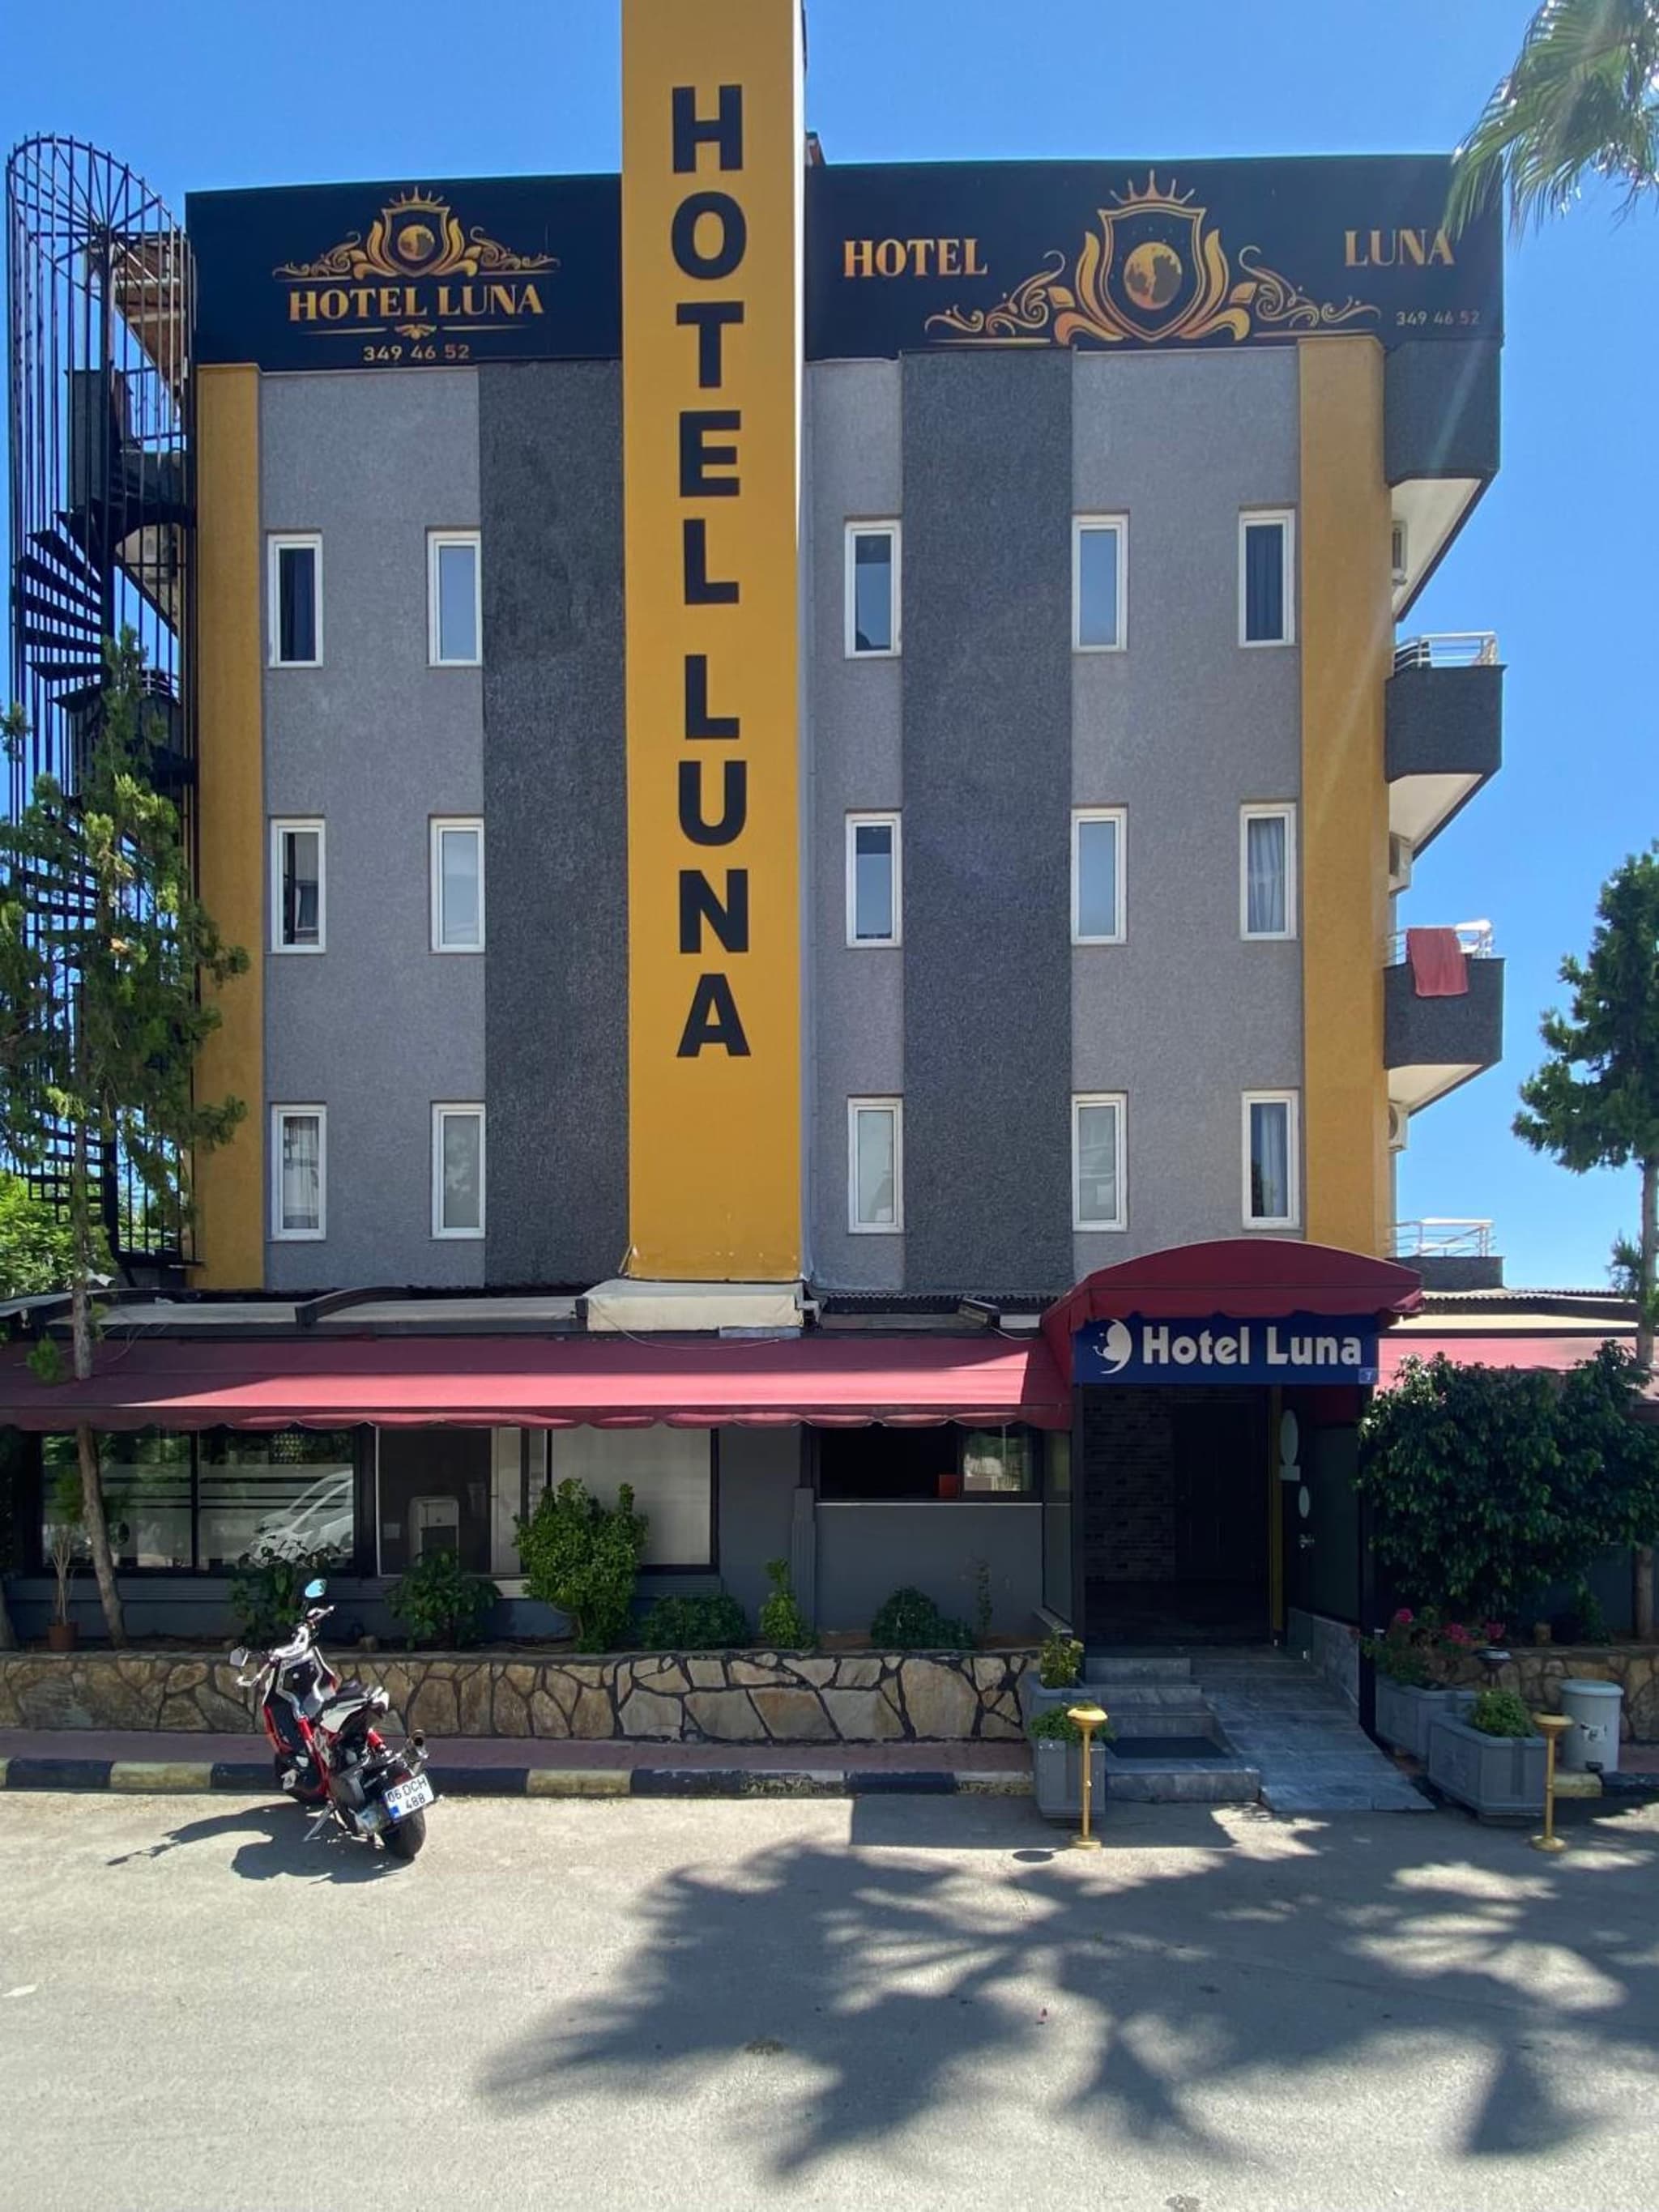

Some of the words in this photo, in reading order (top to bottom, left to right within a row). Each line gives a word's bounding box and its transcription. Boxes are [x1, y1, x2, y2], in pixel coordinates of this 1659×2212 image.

[844, 238, 987, 277] HOTEL
[1345, 228, 1455, 266] LUNA
[288, 286, 427, 321] HOTEL
[438, 283, 544, 315] LUNA
[1396, 311, 1427, 326] 349
[1434, 310, 1453, 324] 46
[1460, 310, 1480, 324] 52
[363, 346, 403, 361] 349
[410, 344, 436, 360] 46
[444, 343, 470, 360] 52
[672, 84, 746, 604] HOTEL
[676, 654, 751, 1057] LUNA
[1142, 1327, 1249, 1365] Hotel
[1267, 1326, 1362, 1365] Luna
[387, 1788, 402, 1802] 06
[406, 1792, 425, 1809] 488
